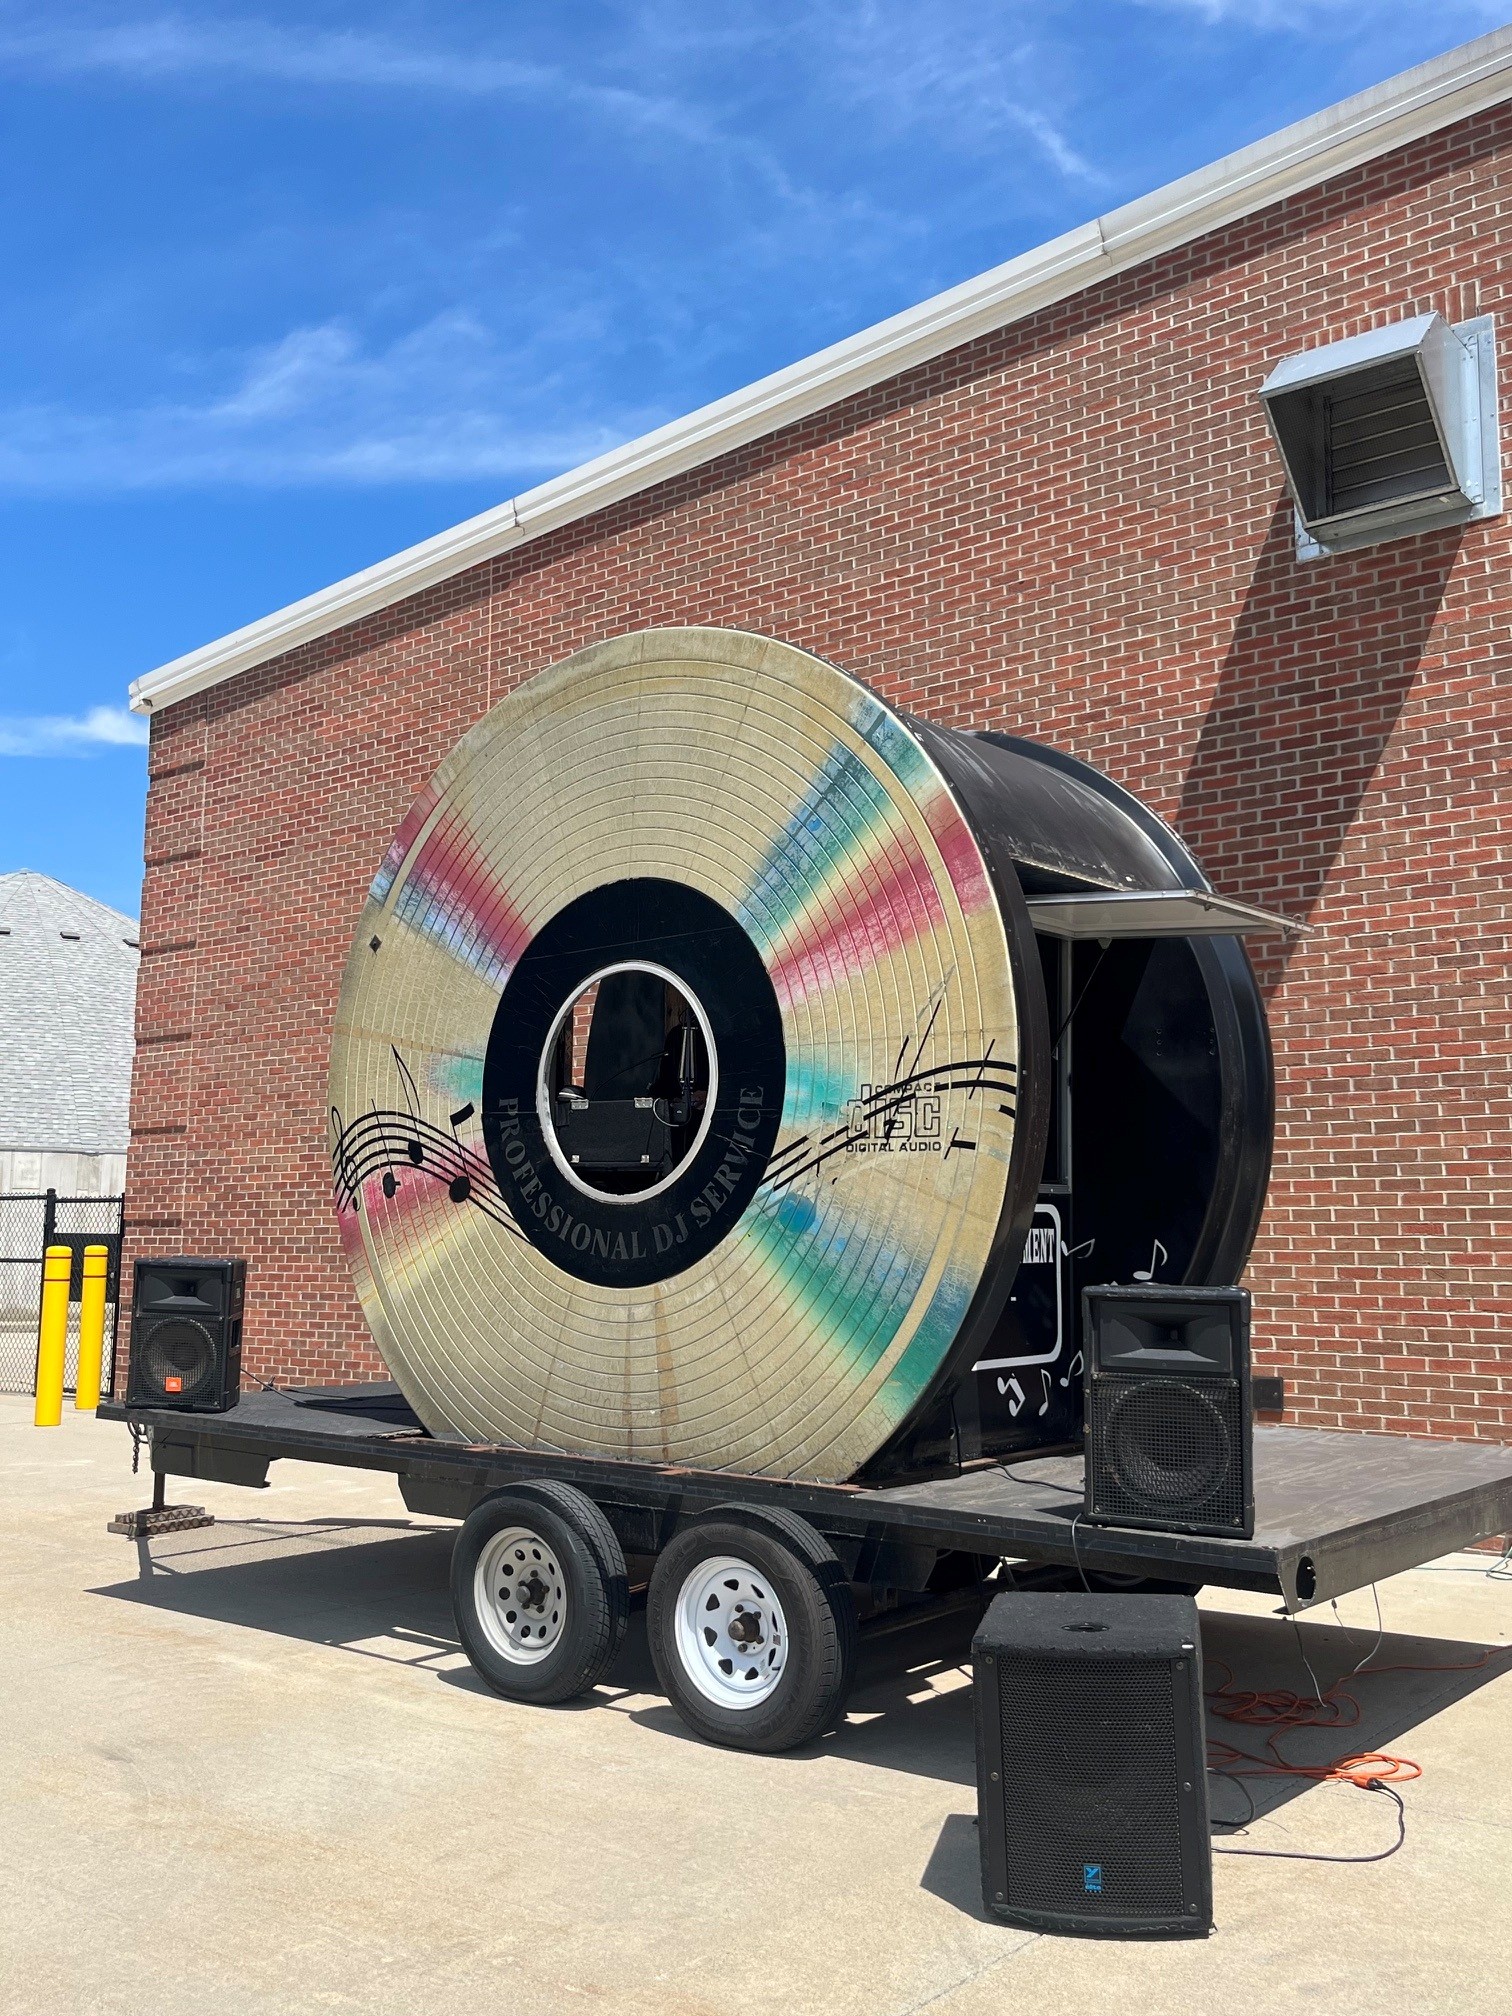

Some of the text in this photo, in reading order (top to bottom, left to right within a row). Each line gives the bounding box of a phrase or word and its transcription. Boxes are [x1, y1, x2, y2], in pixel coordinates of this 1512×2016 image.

[875, 1082, 941, 1094] COMPAC
[846, 1141, 942, 1153] DIGITAL AUDIO
[499, 1086, 765, 1260] PROFESSIONAL DJ SERVICE
